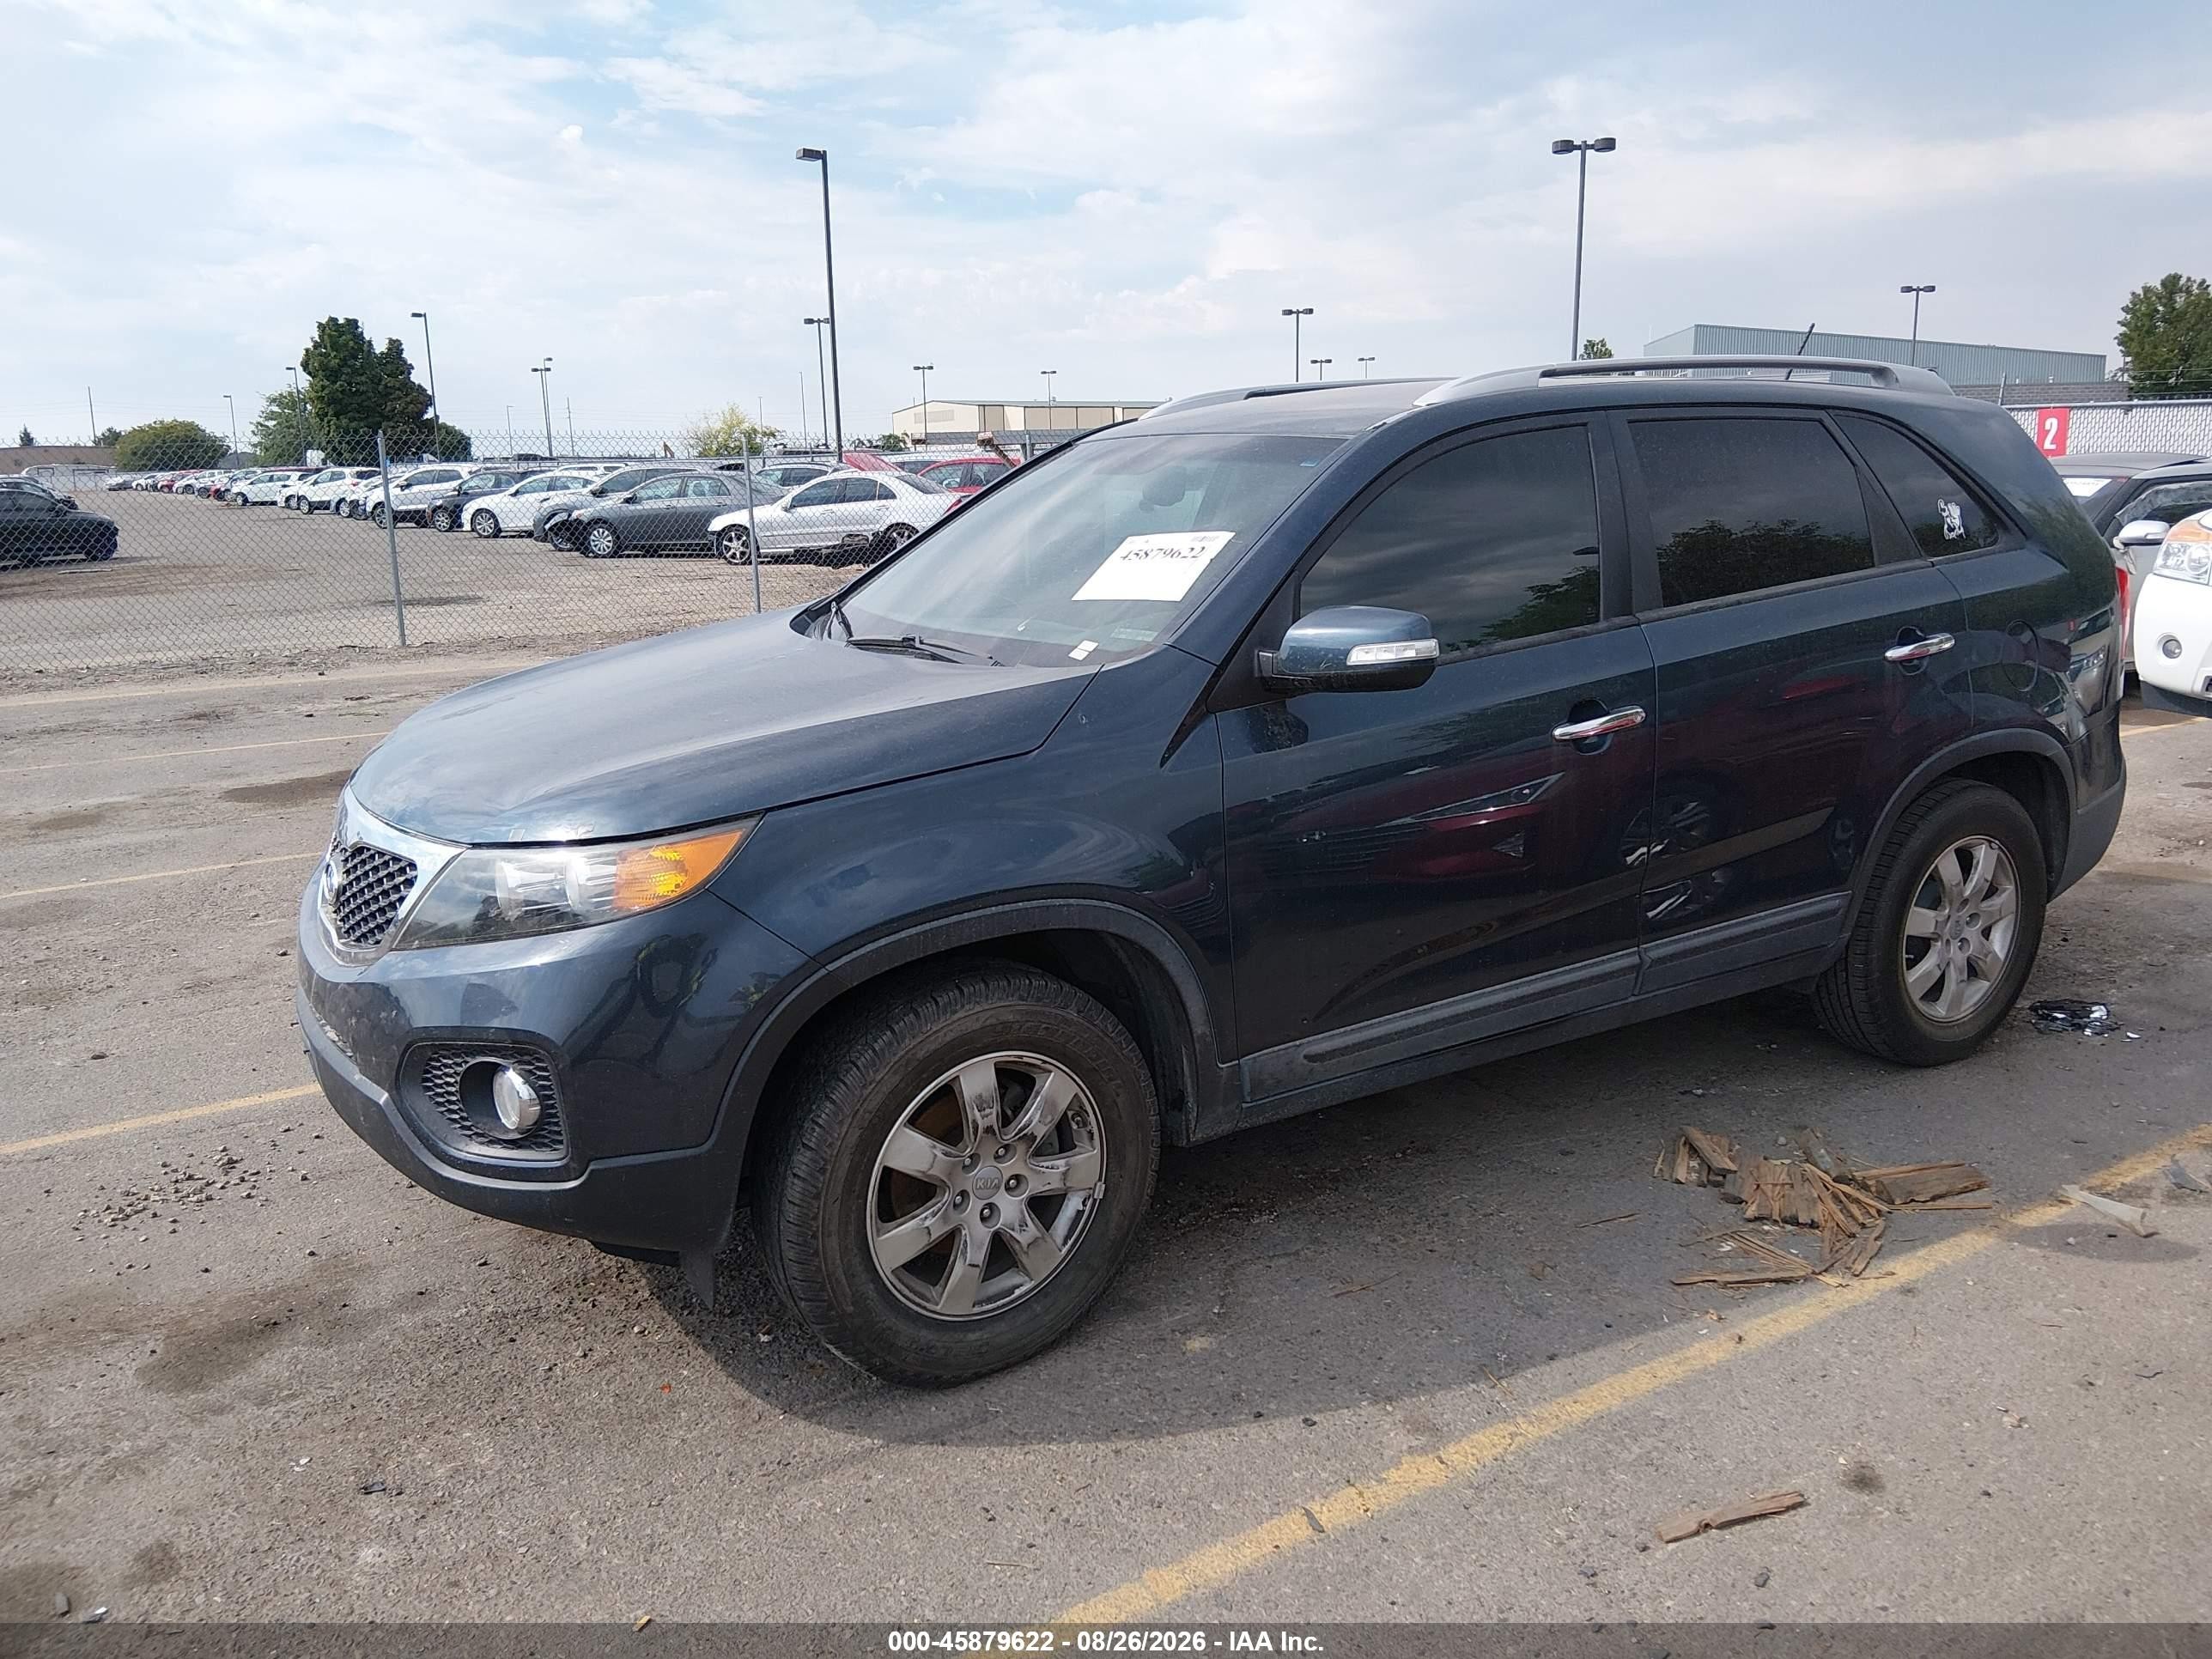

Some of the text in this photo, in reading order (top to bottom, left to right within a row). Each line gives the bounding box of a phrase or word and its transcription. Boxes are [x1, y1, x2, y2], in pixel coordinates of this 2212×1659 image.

[2043, 417, 2058, 451] 2
[1120, 545, 1206, 562] 45879622
[975, 1177, 1000, 1191] KIA
